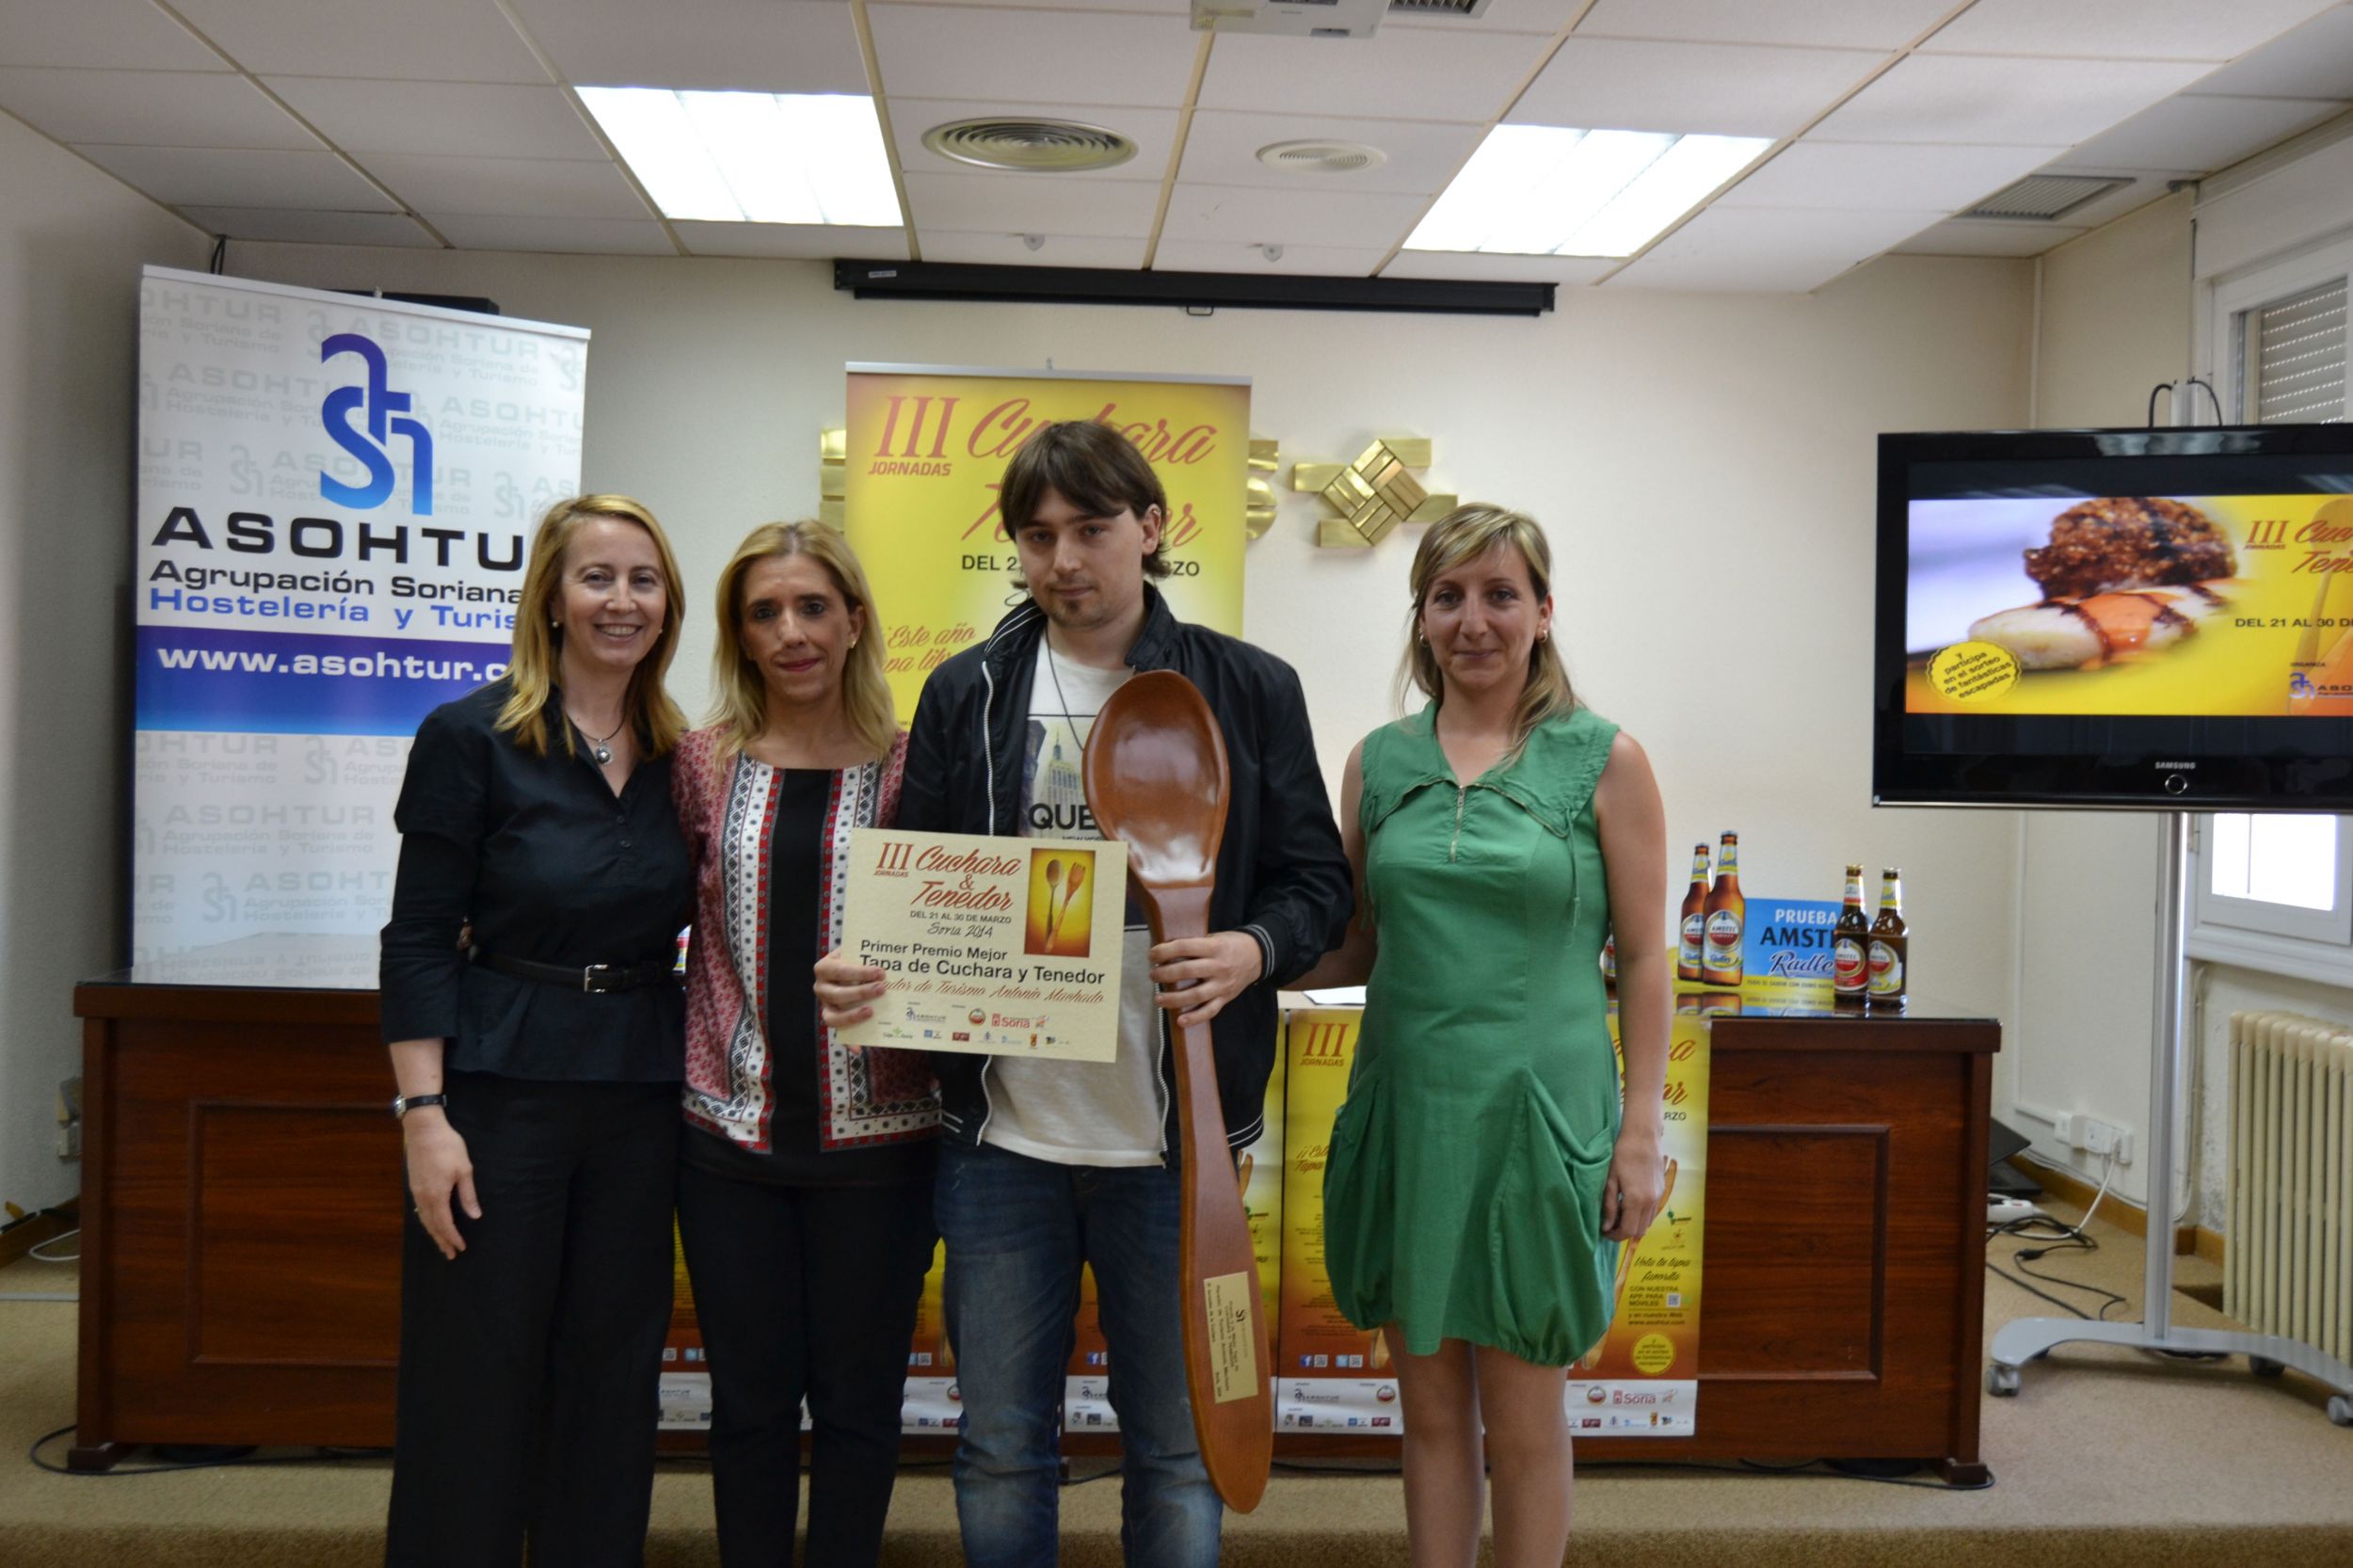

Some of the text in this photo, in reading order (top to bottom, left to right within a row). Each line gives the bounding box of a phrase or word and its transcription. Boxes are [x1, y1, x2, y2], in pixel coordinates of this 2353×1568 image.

[168, 362, 330, 398] ASOHT
[873, 395, 960, 458] III
[868, 461, 952, 476] JORNADAS
[151, 505, 523, 572] ASOHTU
[2246, 520, 2290, 544] III
[962, 554, 1018, 571] DEL 2
[149, 559, 523, 604] Agrupación Soriana
[151, 587, 517, 631] Hostelería y Turis
[2234, 617, 2353, 628] DEL 21 AL 30 D
[888, 622, 976, 649] Este año
[157, 648, 506, 681] www.asohtur.c
[1944, 652, 1987, 675] participa
[2154, 761, 2196, 770] SAMSUNG
[164, 805, 376, 824] ASOHTUR
[1029, 803, 1098, 830] QUE
[876, 842, 1022, 876] III Cuchara
[244, 872, 390, 892] ASOHT
[958, 873, 975, 891] &
[910, 880, 1014, 911] Tenedor
[910, 910, 926, 919] DEL
[929, 911, 938, 920] 21
[966, 914, 978, 922] DE
[980, 915, 1012, 924] MARZO
[1775, 908, 1837, 924] PRUEBA
[927, 922, 994, 939] Soria 2014
[1759, 926, 1836, 949] AMST
[860, 939, 1008, 962] Primer Premio Mejor
[908, 958, 930, 973] de
[936, 960, 1013, 979] Cuchara
[1017, 968, 1028, 983] y
[1033, 966, 1105, 984] Tenedor
[1769, 950, 1834, 977] Radle
[884, 978, 911, 991] ador
[914, 980, 932, 993] de
[1001, 1016, 1032, 1029] Soria
[1303, 1022, 1350, 1058] III
[1300, 1058, 1344, 1066] JORNADAS
[1624, 1393, 1657, 1405] Soria
